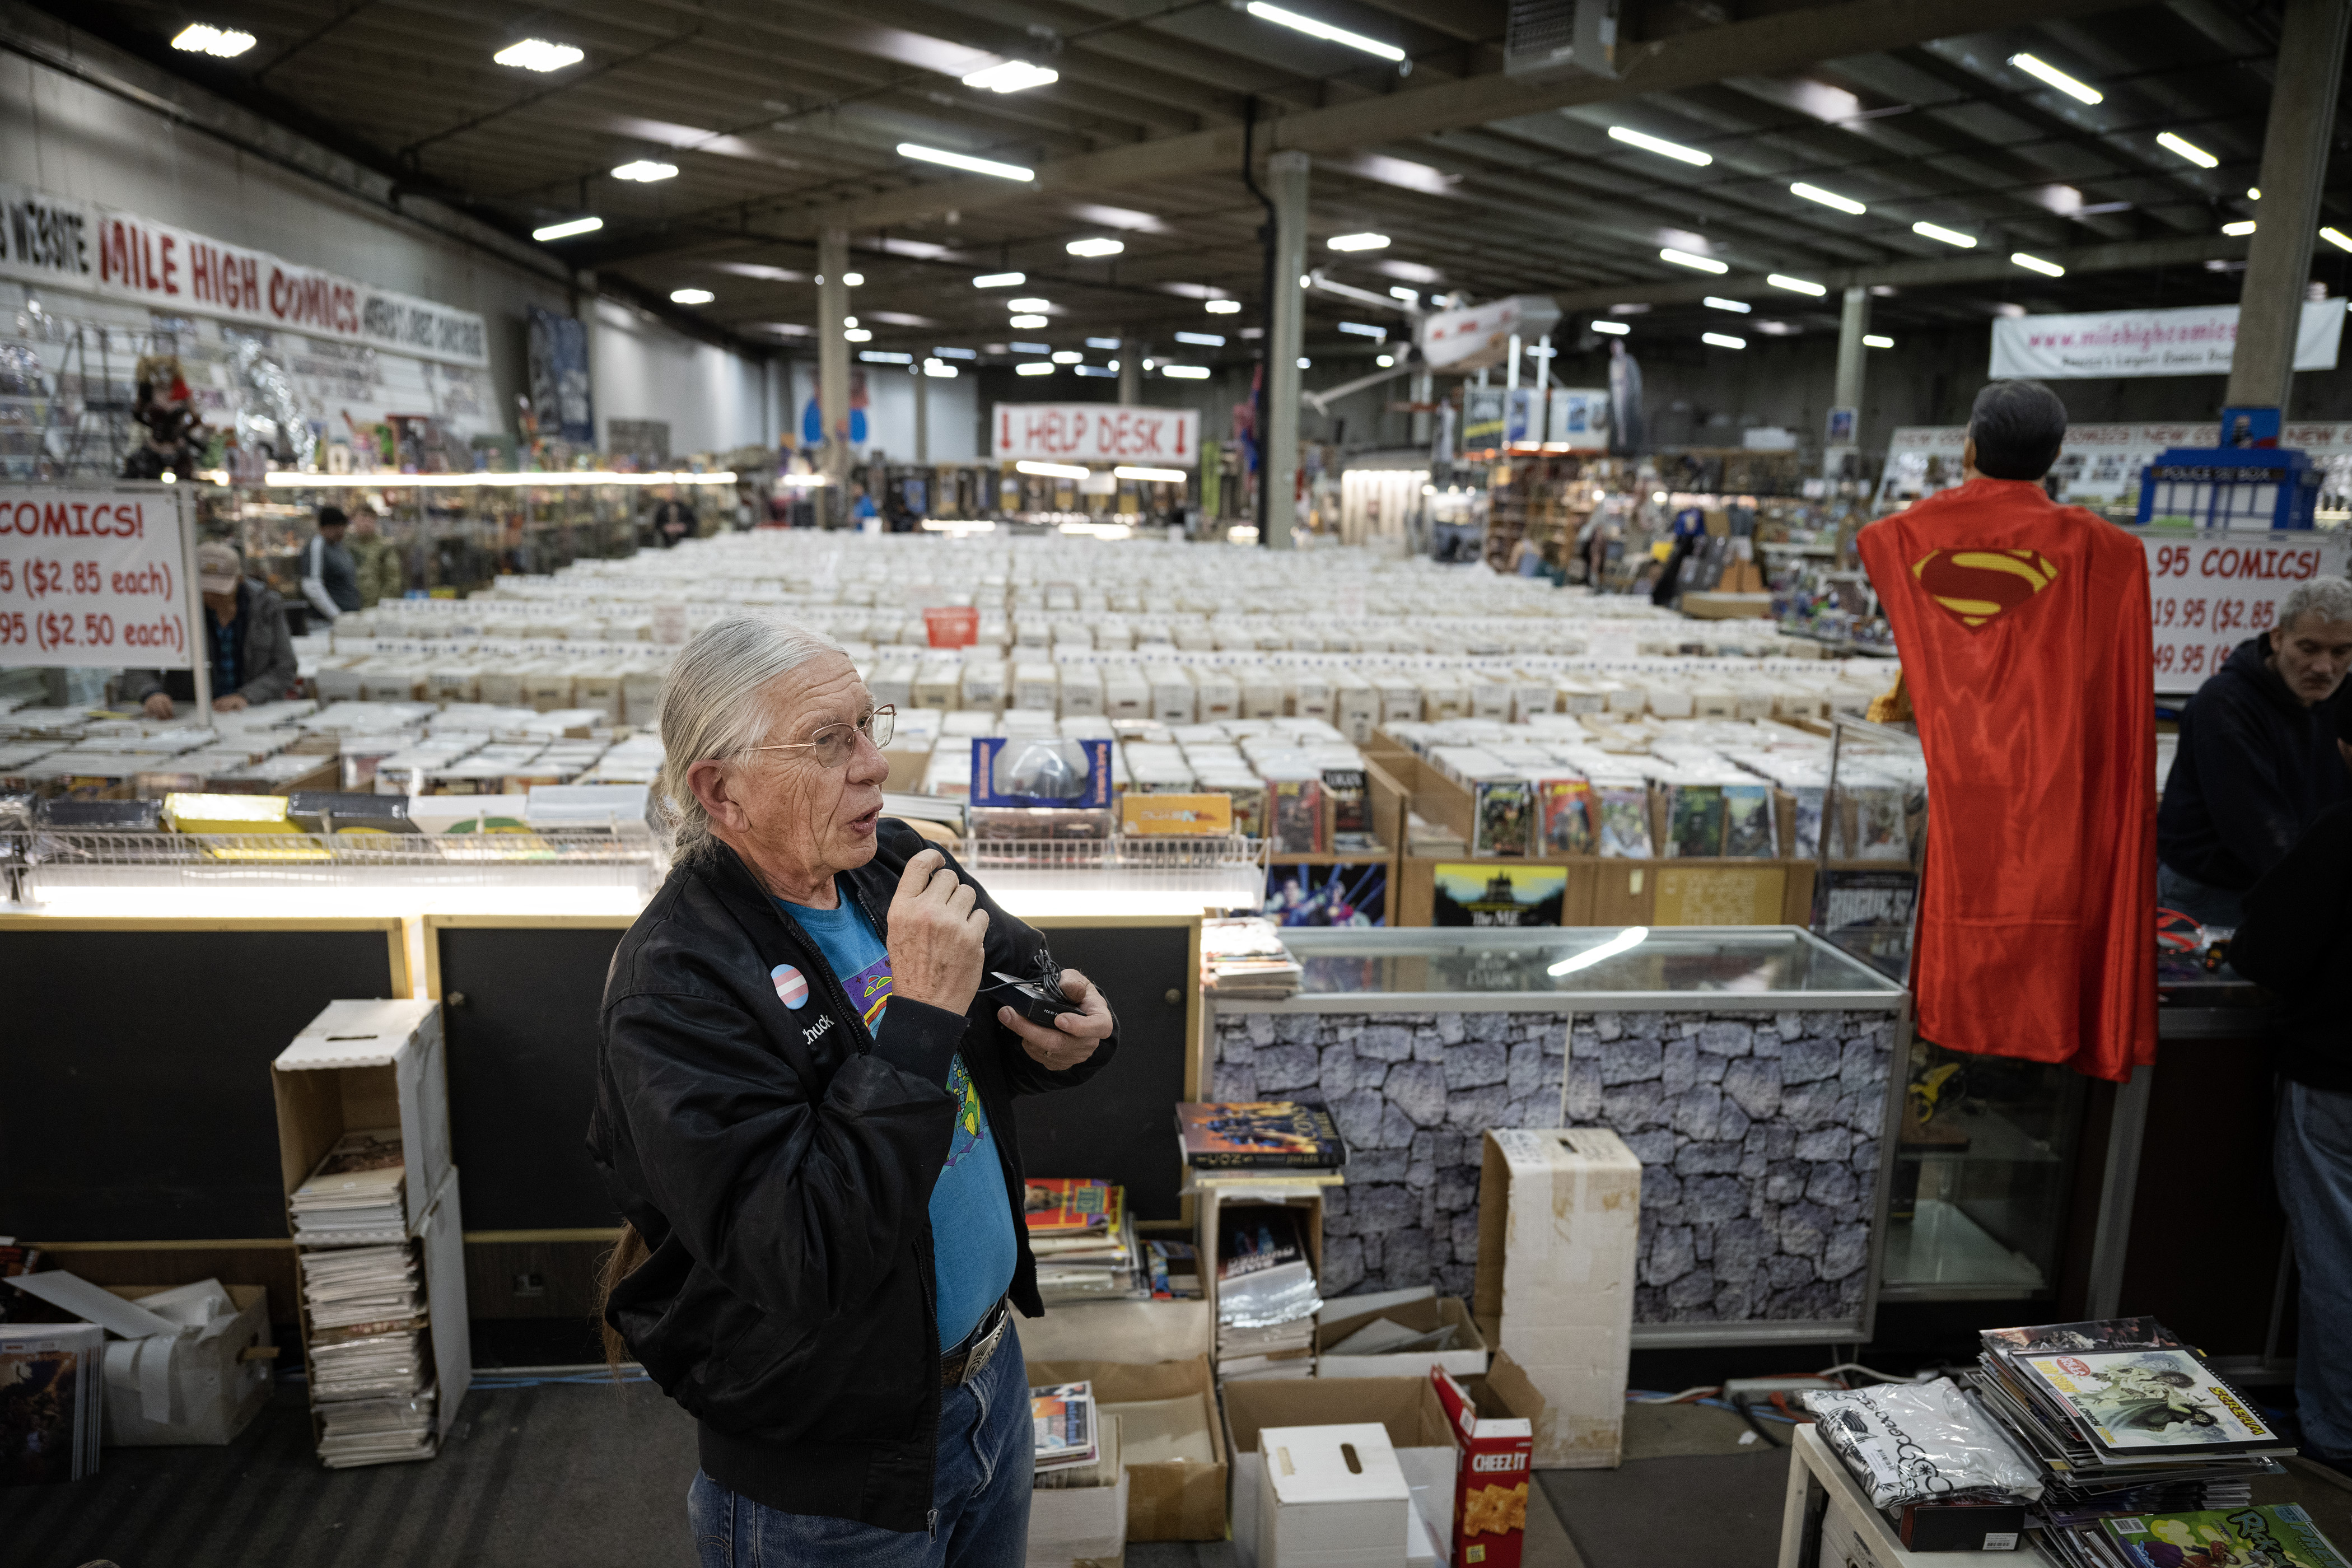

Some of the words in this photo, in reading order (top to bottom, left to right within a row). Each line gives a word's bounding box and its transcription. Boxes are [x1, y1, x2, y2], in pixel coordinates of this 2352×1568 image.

[98, 219, 181, 295] MILE
[188, 241, 262, 311] HIGH
[268, 266, 359, 333] COMICS
[1025, 410, 1089, 453] HELP
[1098, 412, 1164, 455] DESK
[24, 557, 102, 601] ($2.85
[112, 562, 174, 602] each)
[2200, 547, 2321, 581] COMICS!
[36, 609, 114, 651] ($2.50
[124, 613, 184, 654] each)
[802, 1014, 835, 1045] huck
[2068, 1396, 2084, 1407] EVIL
[2079, 1408, 2103, 1427] ORIGIN
[2207, 1387, 2267, 1435] SCREAM
